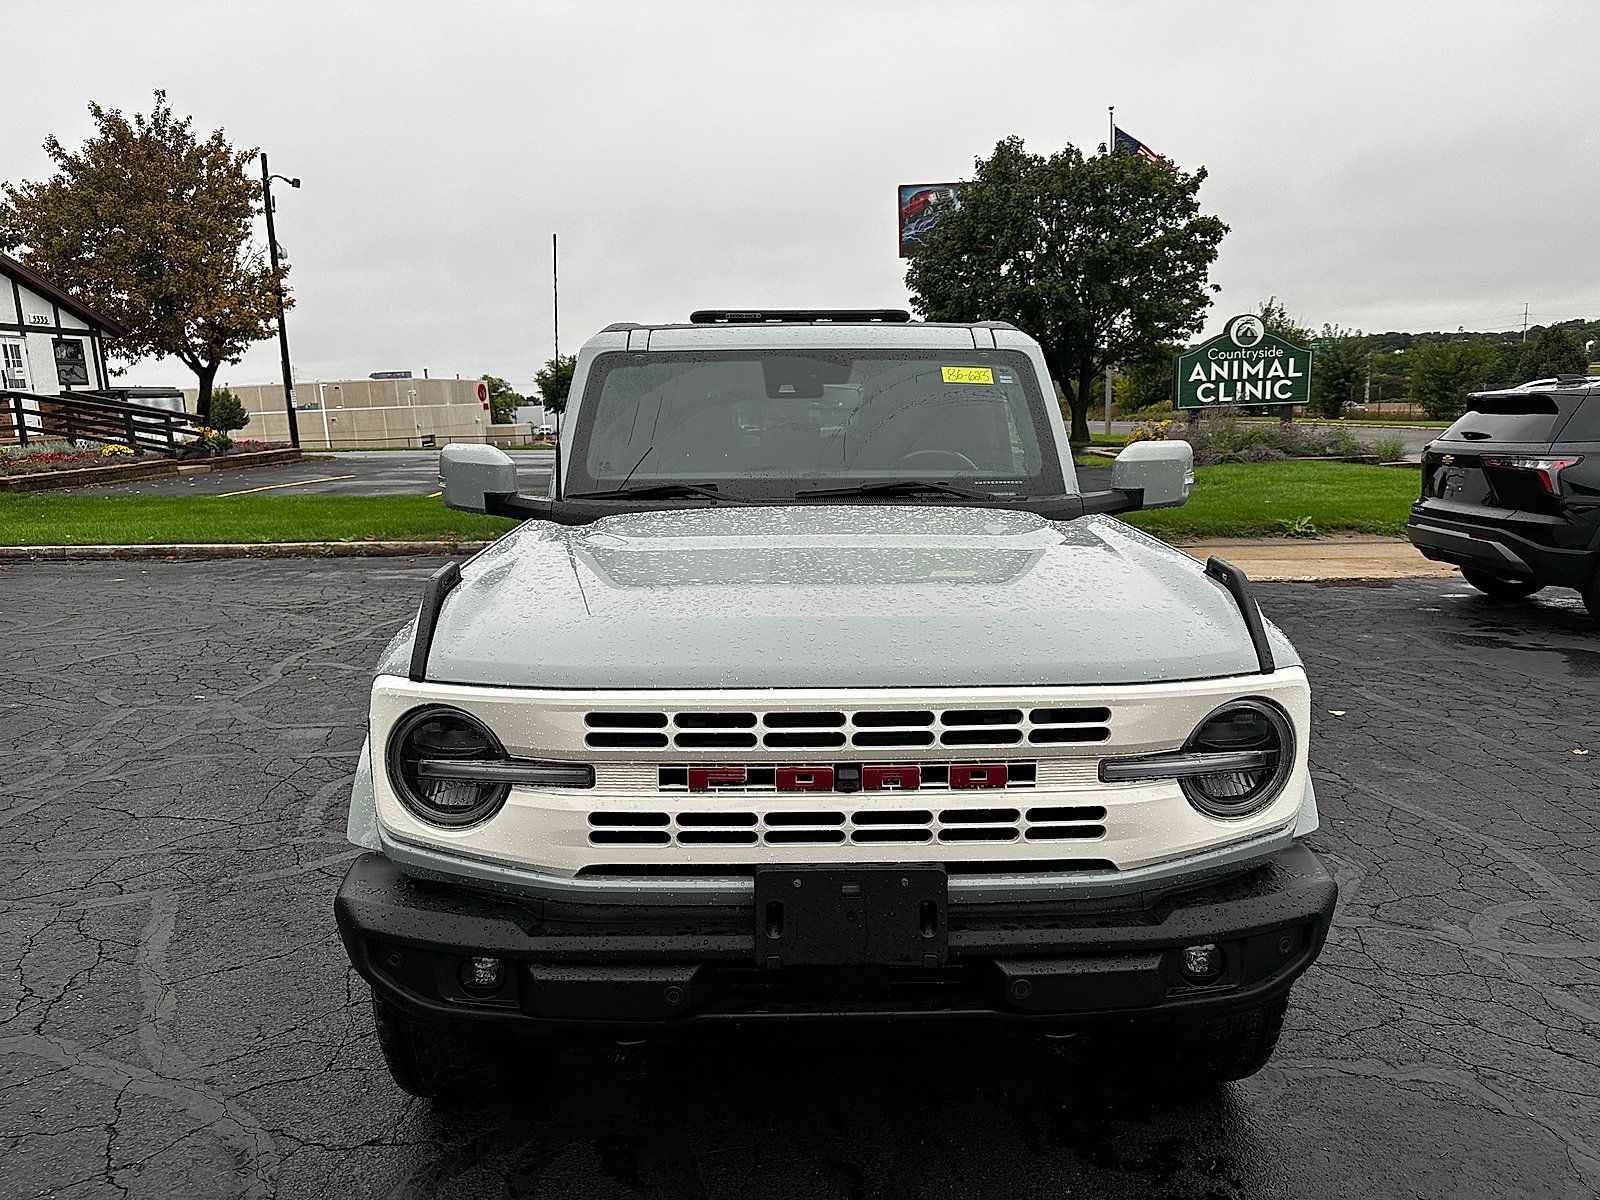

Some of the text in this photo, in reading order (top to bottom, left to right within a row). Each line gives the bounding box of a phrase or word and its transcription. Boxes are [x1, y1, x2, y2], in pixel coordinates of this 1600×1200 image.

[1207, 345, 1284, 361] Countryside
[1188, 358, 1303, 382] ANIMAL
[1196, 379, 1293, 403] CLINIC
[688, 764, 1009, 791] FORD
